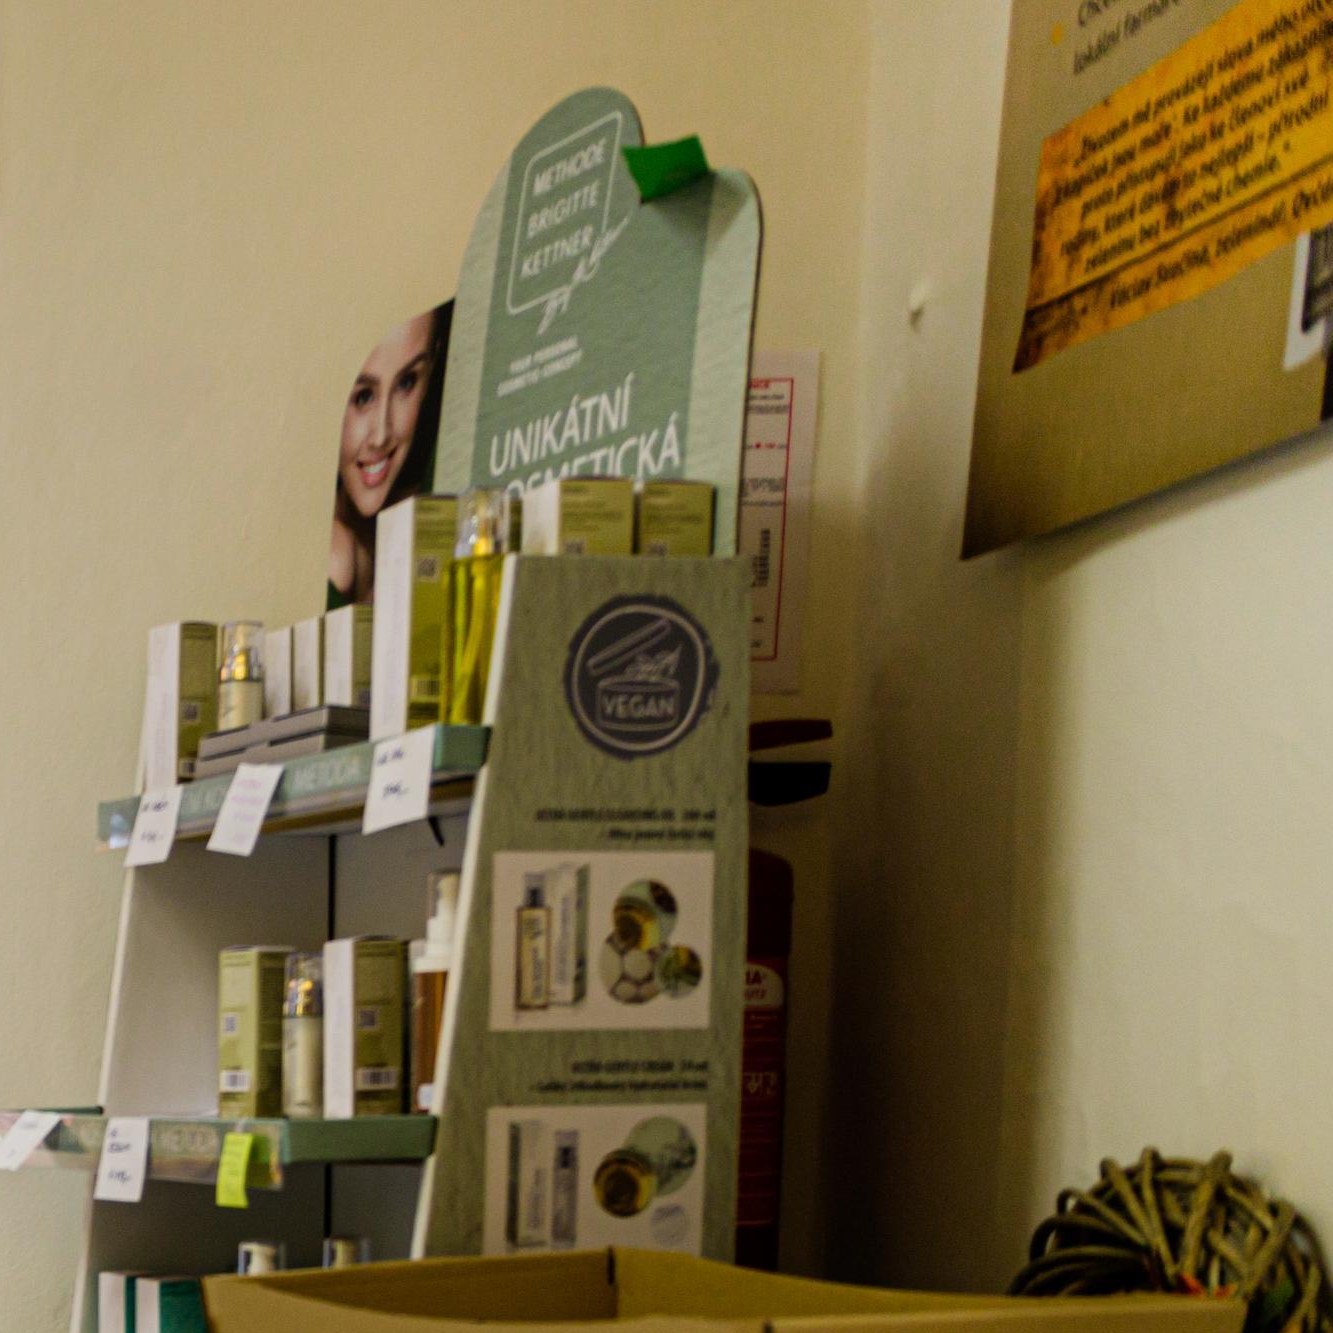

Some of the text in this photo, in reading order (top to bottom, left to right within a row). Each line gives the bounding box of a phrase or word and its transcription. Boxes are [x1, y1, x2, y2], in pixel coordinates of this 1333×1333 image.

[534, 138, 607, 197] METHODE
[526, 179, 601, 240] BRIGITTE
[520, 223, 594, 282] KETTNER
[489, 371, 637, 477] UNIKÁTNÍ
[600, 693, 675, 719] VEGAN
